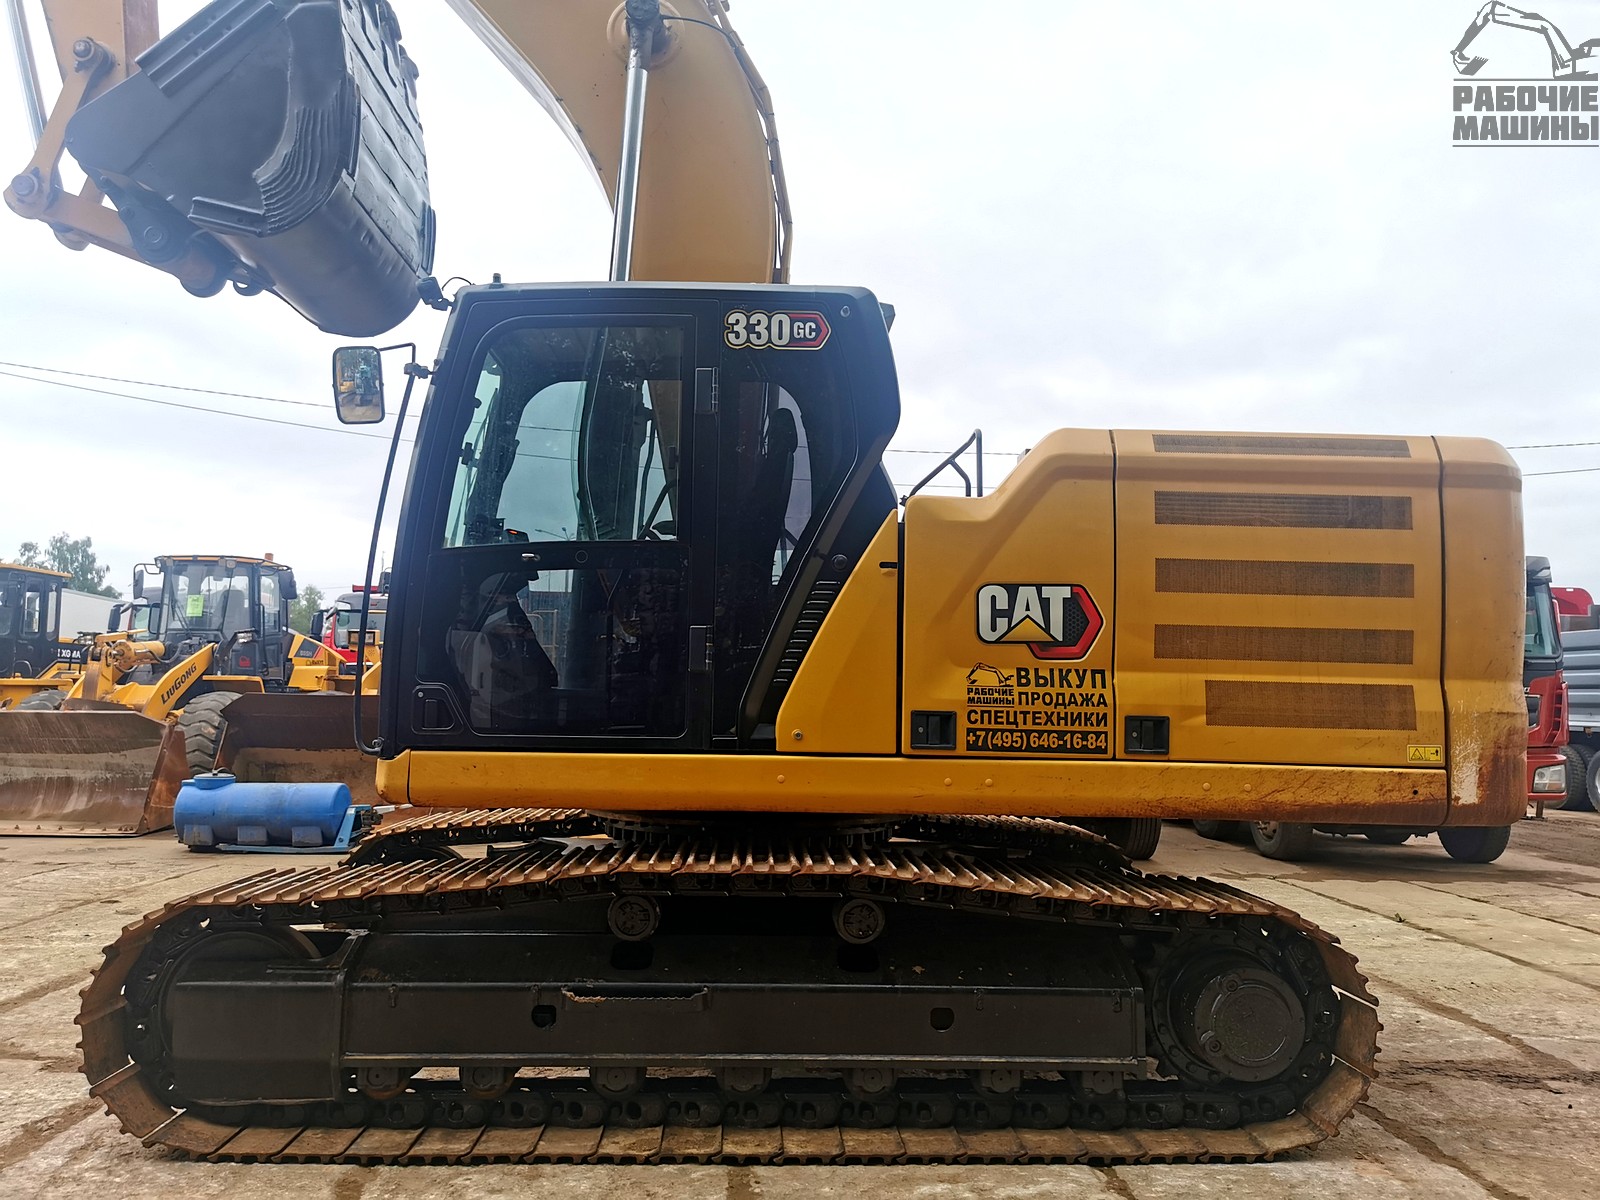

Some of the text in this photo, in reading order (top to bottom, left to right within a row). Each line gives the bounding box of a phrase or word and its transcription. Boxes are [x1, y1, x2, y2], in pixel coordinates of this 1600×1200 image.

[727, 312, 816, 346] 330 GC
[978, 584, 1072, 642] CAT
[1016, 667, 1107, 689] ВЫКУП
[967, 687, 1014, 697] РАБОЧИЕ
[967, 696, 1014, 705] МАШИНЫ
[1018, 691, 1108, 709] ПРОДАЖА
[967, 709, 1108, 728] СПЕЦТЕХНИКИ
[1029, 733, 1107, 750] 646-16-84
